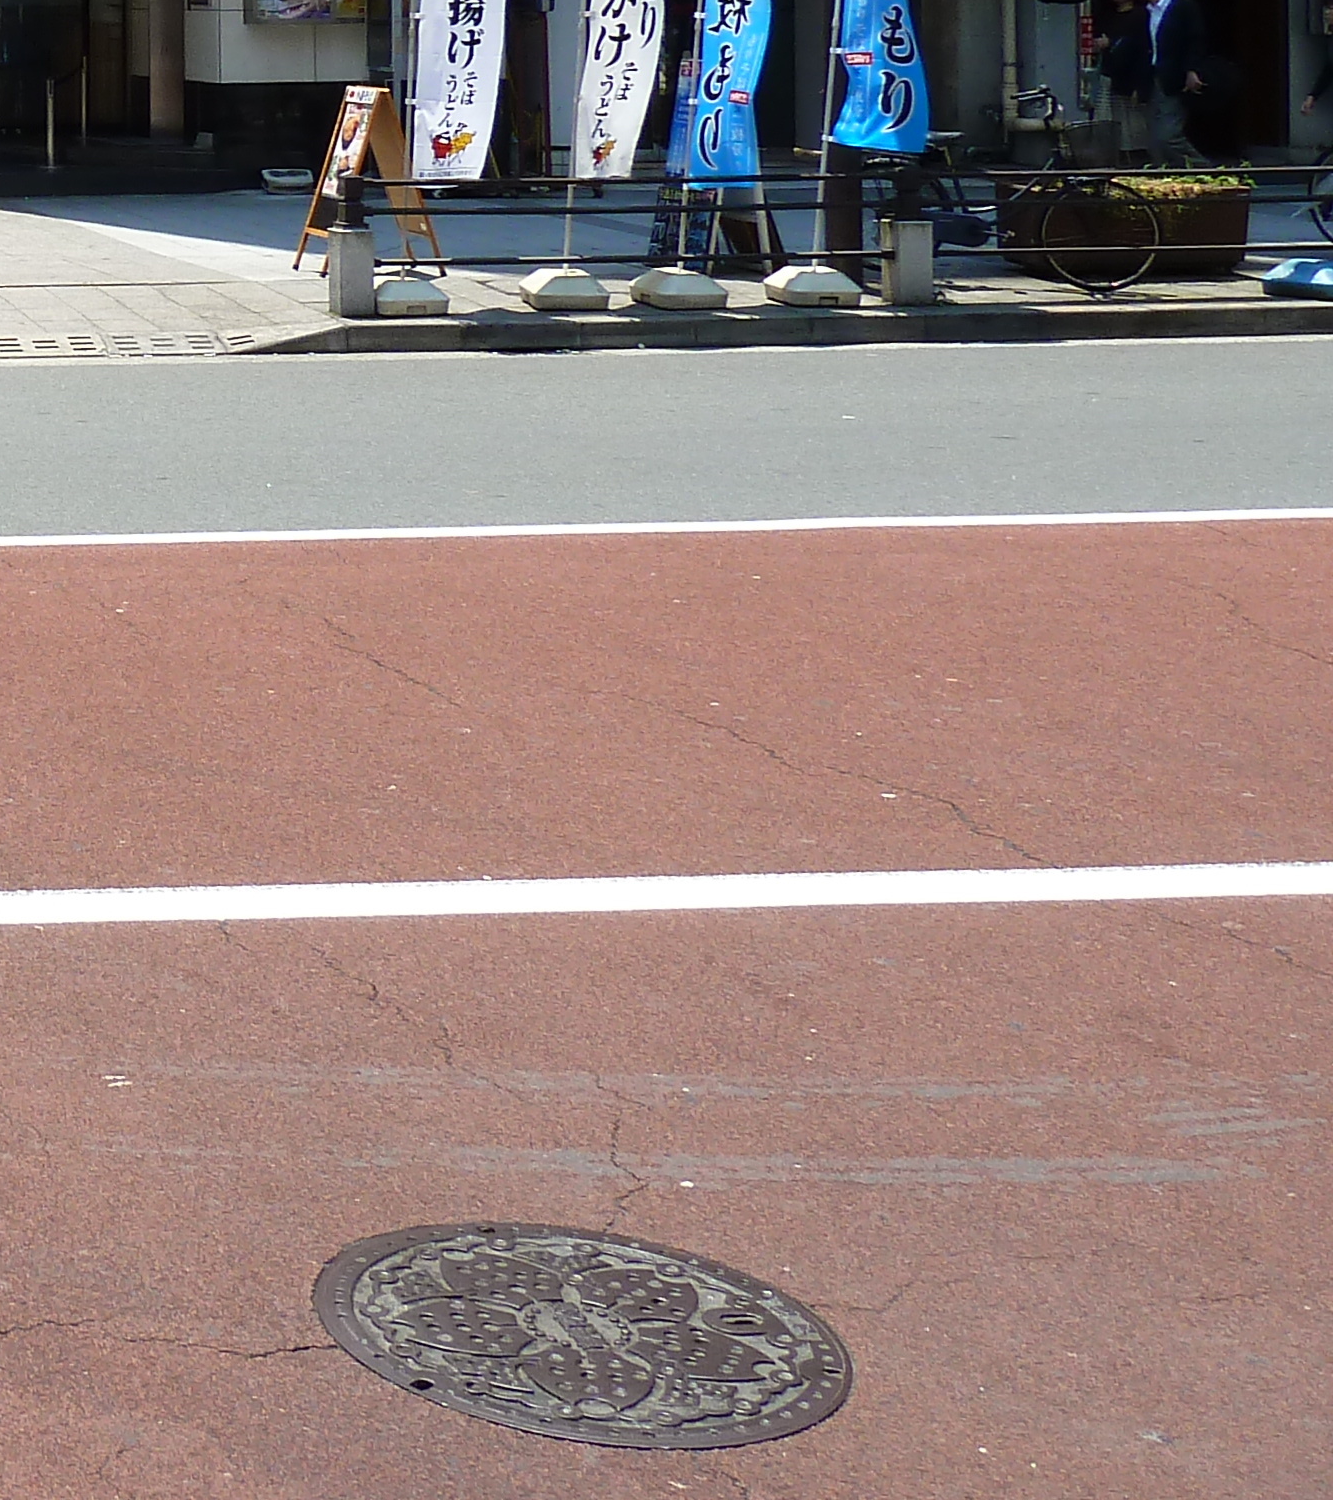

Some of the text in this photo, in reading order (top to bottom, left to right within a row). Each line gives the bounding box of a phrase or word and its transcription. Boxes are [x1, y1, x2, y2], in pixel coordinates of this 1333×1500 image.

[436, 73, 459, 129] うどん
[460, 71, 479, 105] そば
[616, 62, 639, 101] そば
[590, 73, 614, 139] うどん
